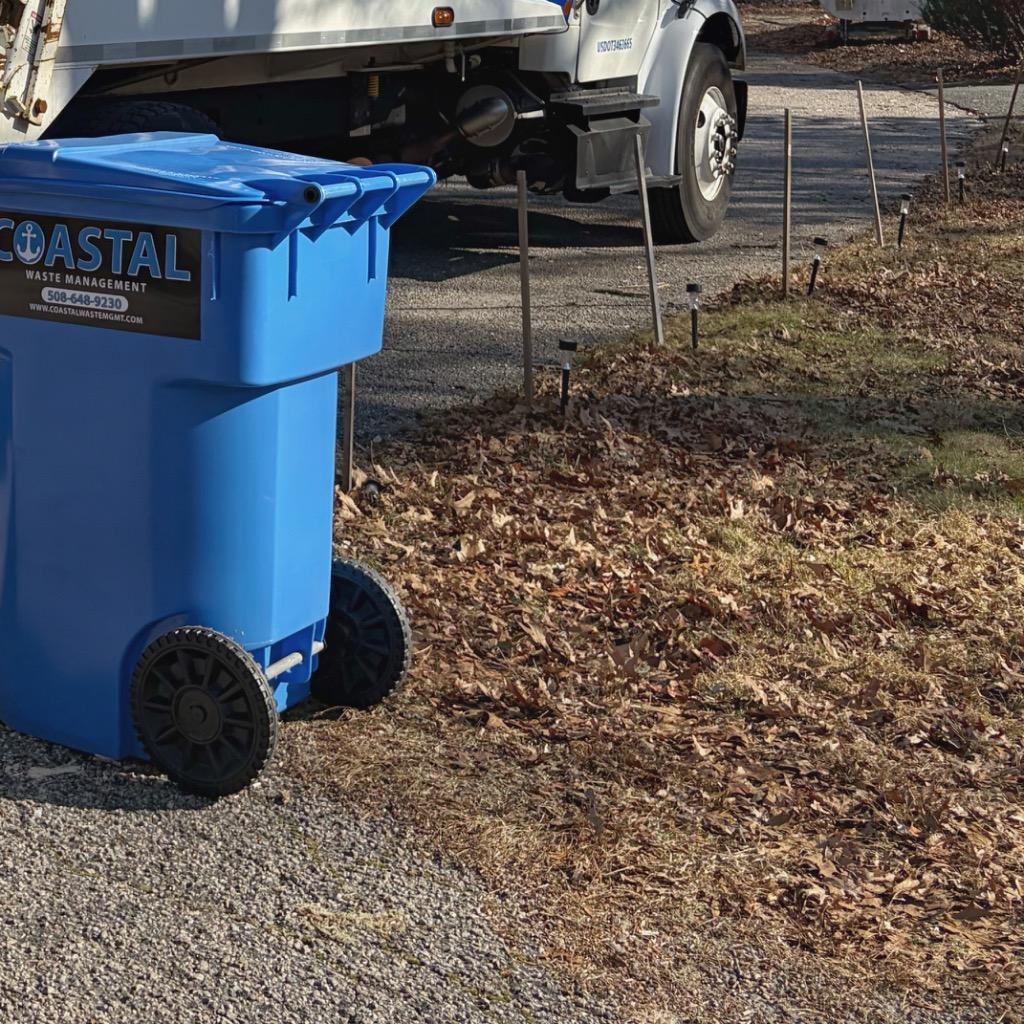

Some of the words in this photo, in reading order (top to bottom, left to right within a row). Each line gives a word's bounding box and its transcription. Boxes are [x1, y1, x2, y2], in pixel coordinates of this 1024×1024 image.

[25, 269, 61, 283] WASTE
[65, 274, 147, 293] MANAGEMENT
[47, 290, 122, 310] 508-648-9230
[29, 303, 143, 324] WWW.COASTALWASTEMGMT.COM
